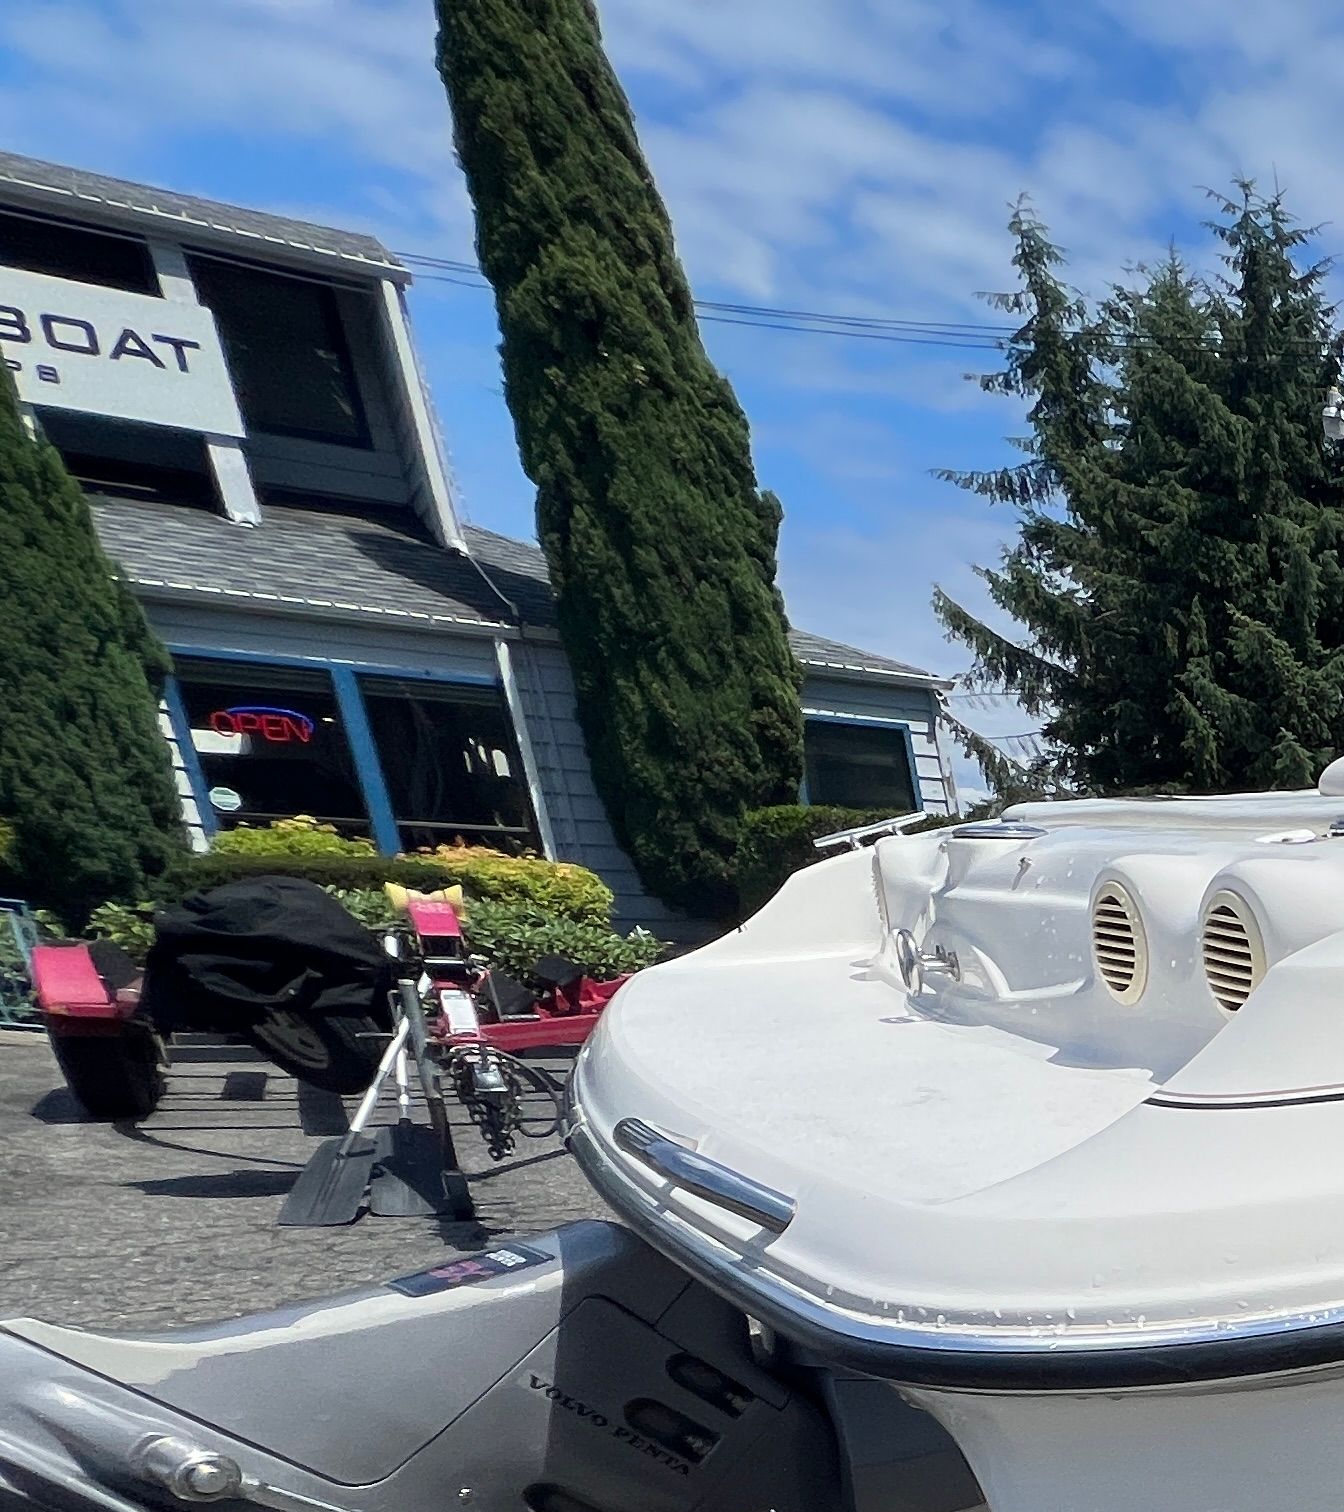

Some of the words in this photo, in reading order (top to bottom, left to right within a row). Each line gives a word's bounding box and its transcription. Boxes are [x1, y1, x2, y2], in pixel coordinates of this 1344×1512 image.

[209, 711, 310, 742] OPEN
[529, 1374, 609, 1427] VOLVO
[612, 1426, 690, 1479] PENTA
